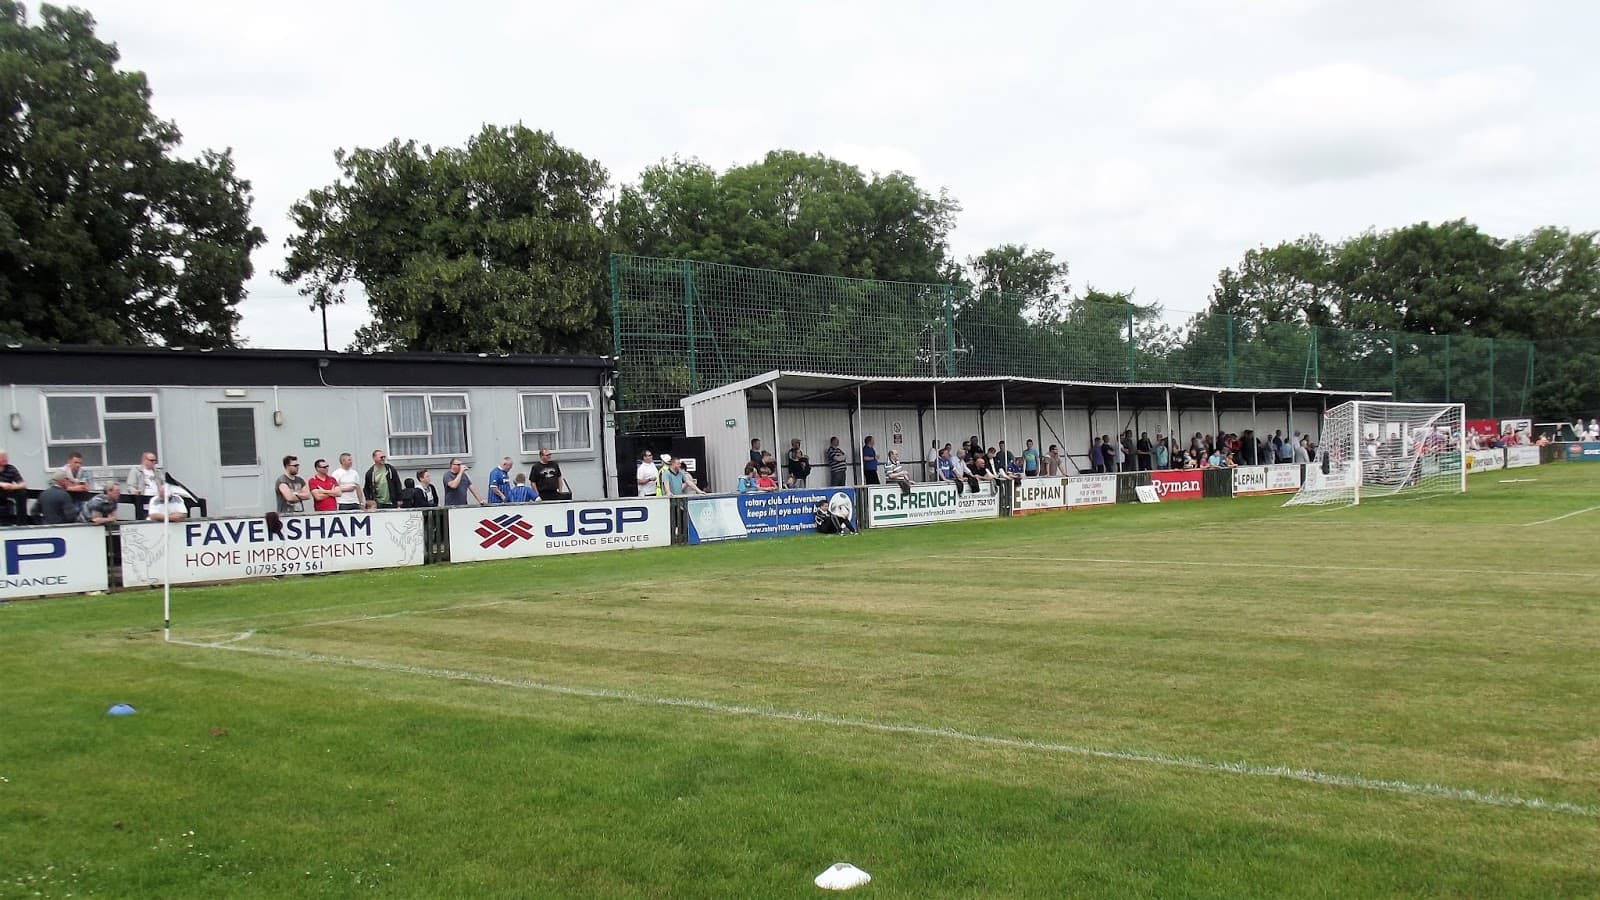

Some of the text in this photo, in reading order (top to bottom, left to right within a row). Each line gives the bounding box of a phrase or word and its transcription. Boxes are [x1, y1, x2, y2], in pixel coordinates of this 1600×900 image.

[1151, 479, 1201, 497] Ryman
[745, 494, 826, 508] rotary club of faversham
[873, 489, 957, 512] R.S.FRENCH
[747, 510, 767, 519] keeps
[768, 508, 777, 516] its
[779, 508, 791, 517] eye
[802, 505, 813, 513] the
[909, 508, 957, 518] www.rsfrench.com
[544, 506, 649, 538] JSP
[546, 534, 650, 549] BUILDING SERVICES
[186, 542, 374, 568] HOME IMPROVEMENTS
[245, 561, 324, 575] 01795 597 561
